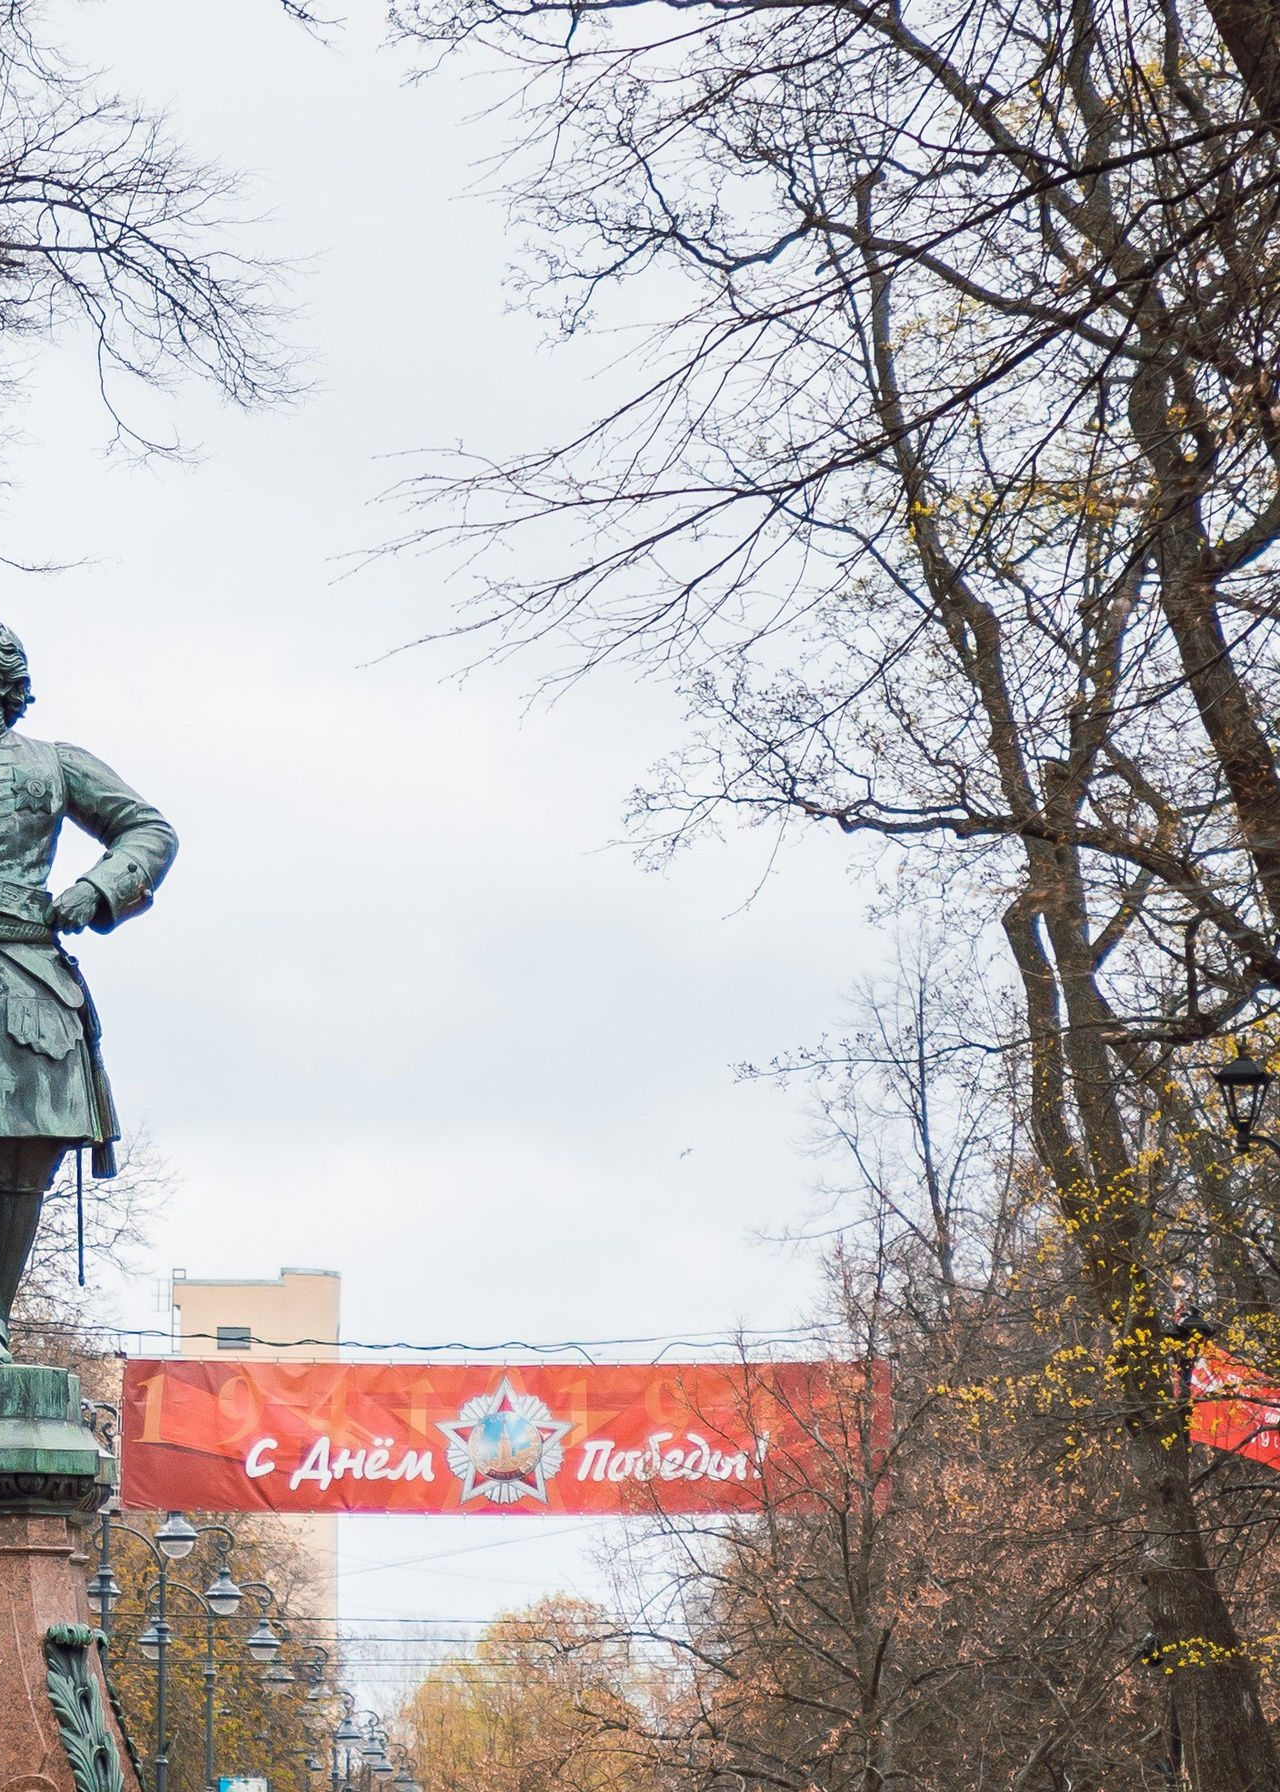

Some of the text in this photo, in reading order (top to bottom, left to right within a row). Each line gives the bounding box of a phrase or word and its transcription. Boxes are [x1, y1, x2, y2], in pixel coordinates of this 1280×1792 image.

[244, 1431, 771, 1491] С Днём Победы!
